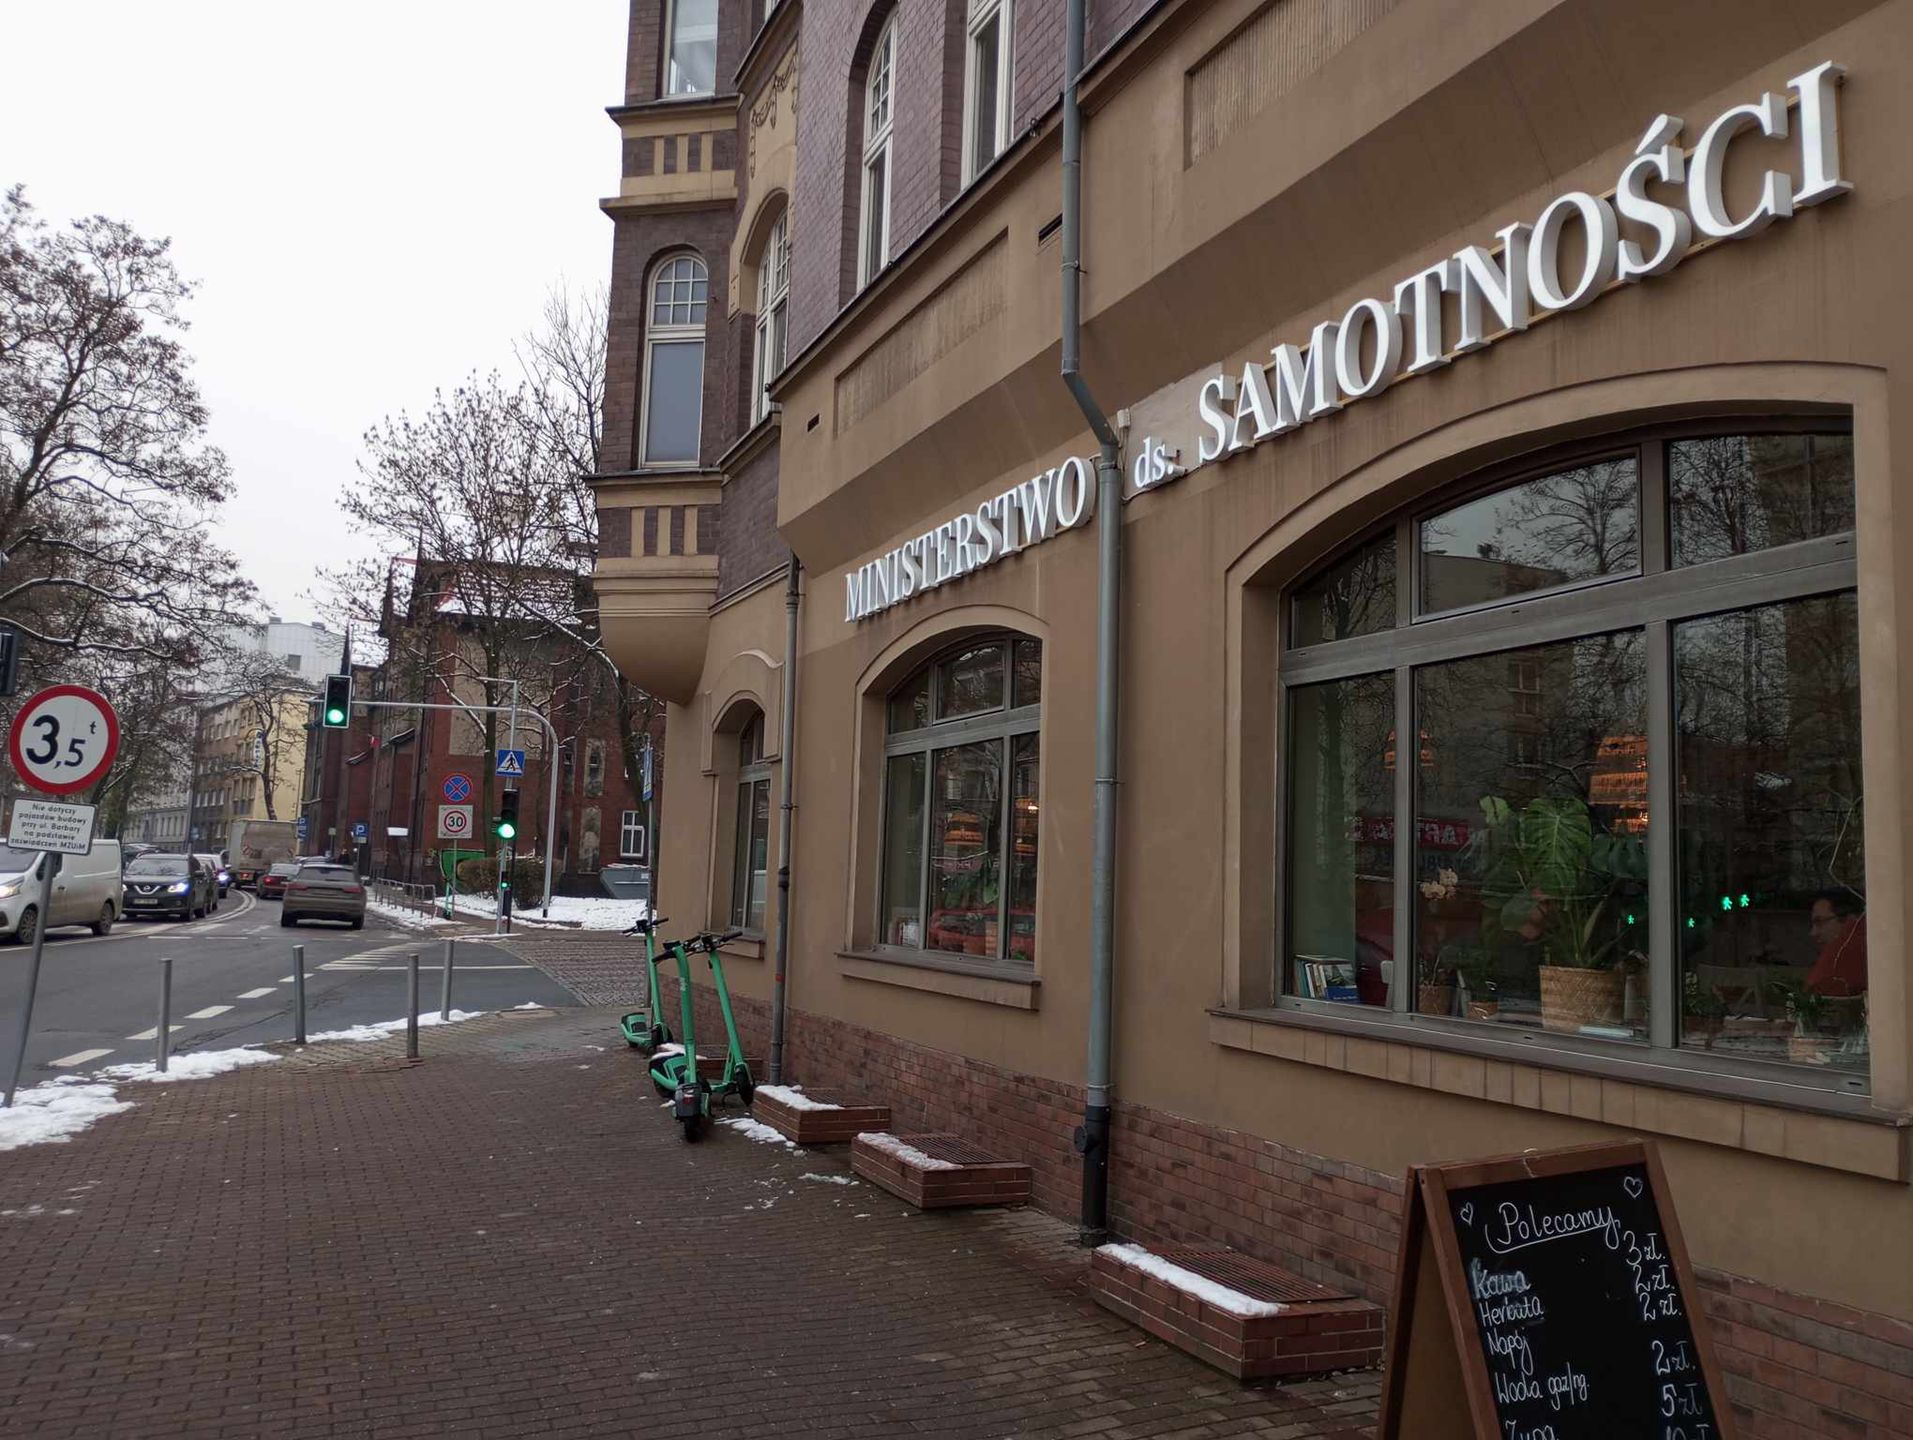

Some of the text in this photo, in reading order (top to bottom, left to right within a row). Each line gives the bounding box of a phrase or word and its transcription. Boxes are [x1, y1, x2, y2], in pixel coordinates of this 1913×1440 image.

[846, 60, 1853, 622] MINISTERSTWO ds. SAMOTNOŚCI
[32, 803, 77, 815] Nie dotyczy
[57, 816, 87, 825] budowy
[448, 816, 464, 828] 30
[22, 822, 36, 830] przy
[51, 824, 81, 834] Barbary
[36, 832, 76, 841] podstawie
[1497, 1202, 1620, 1249] Polecamy
[1472, 1257, 1530, 1299] Kawa
[1495, 1371, 1543, 1404] Woda
